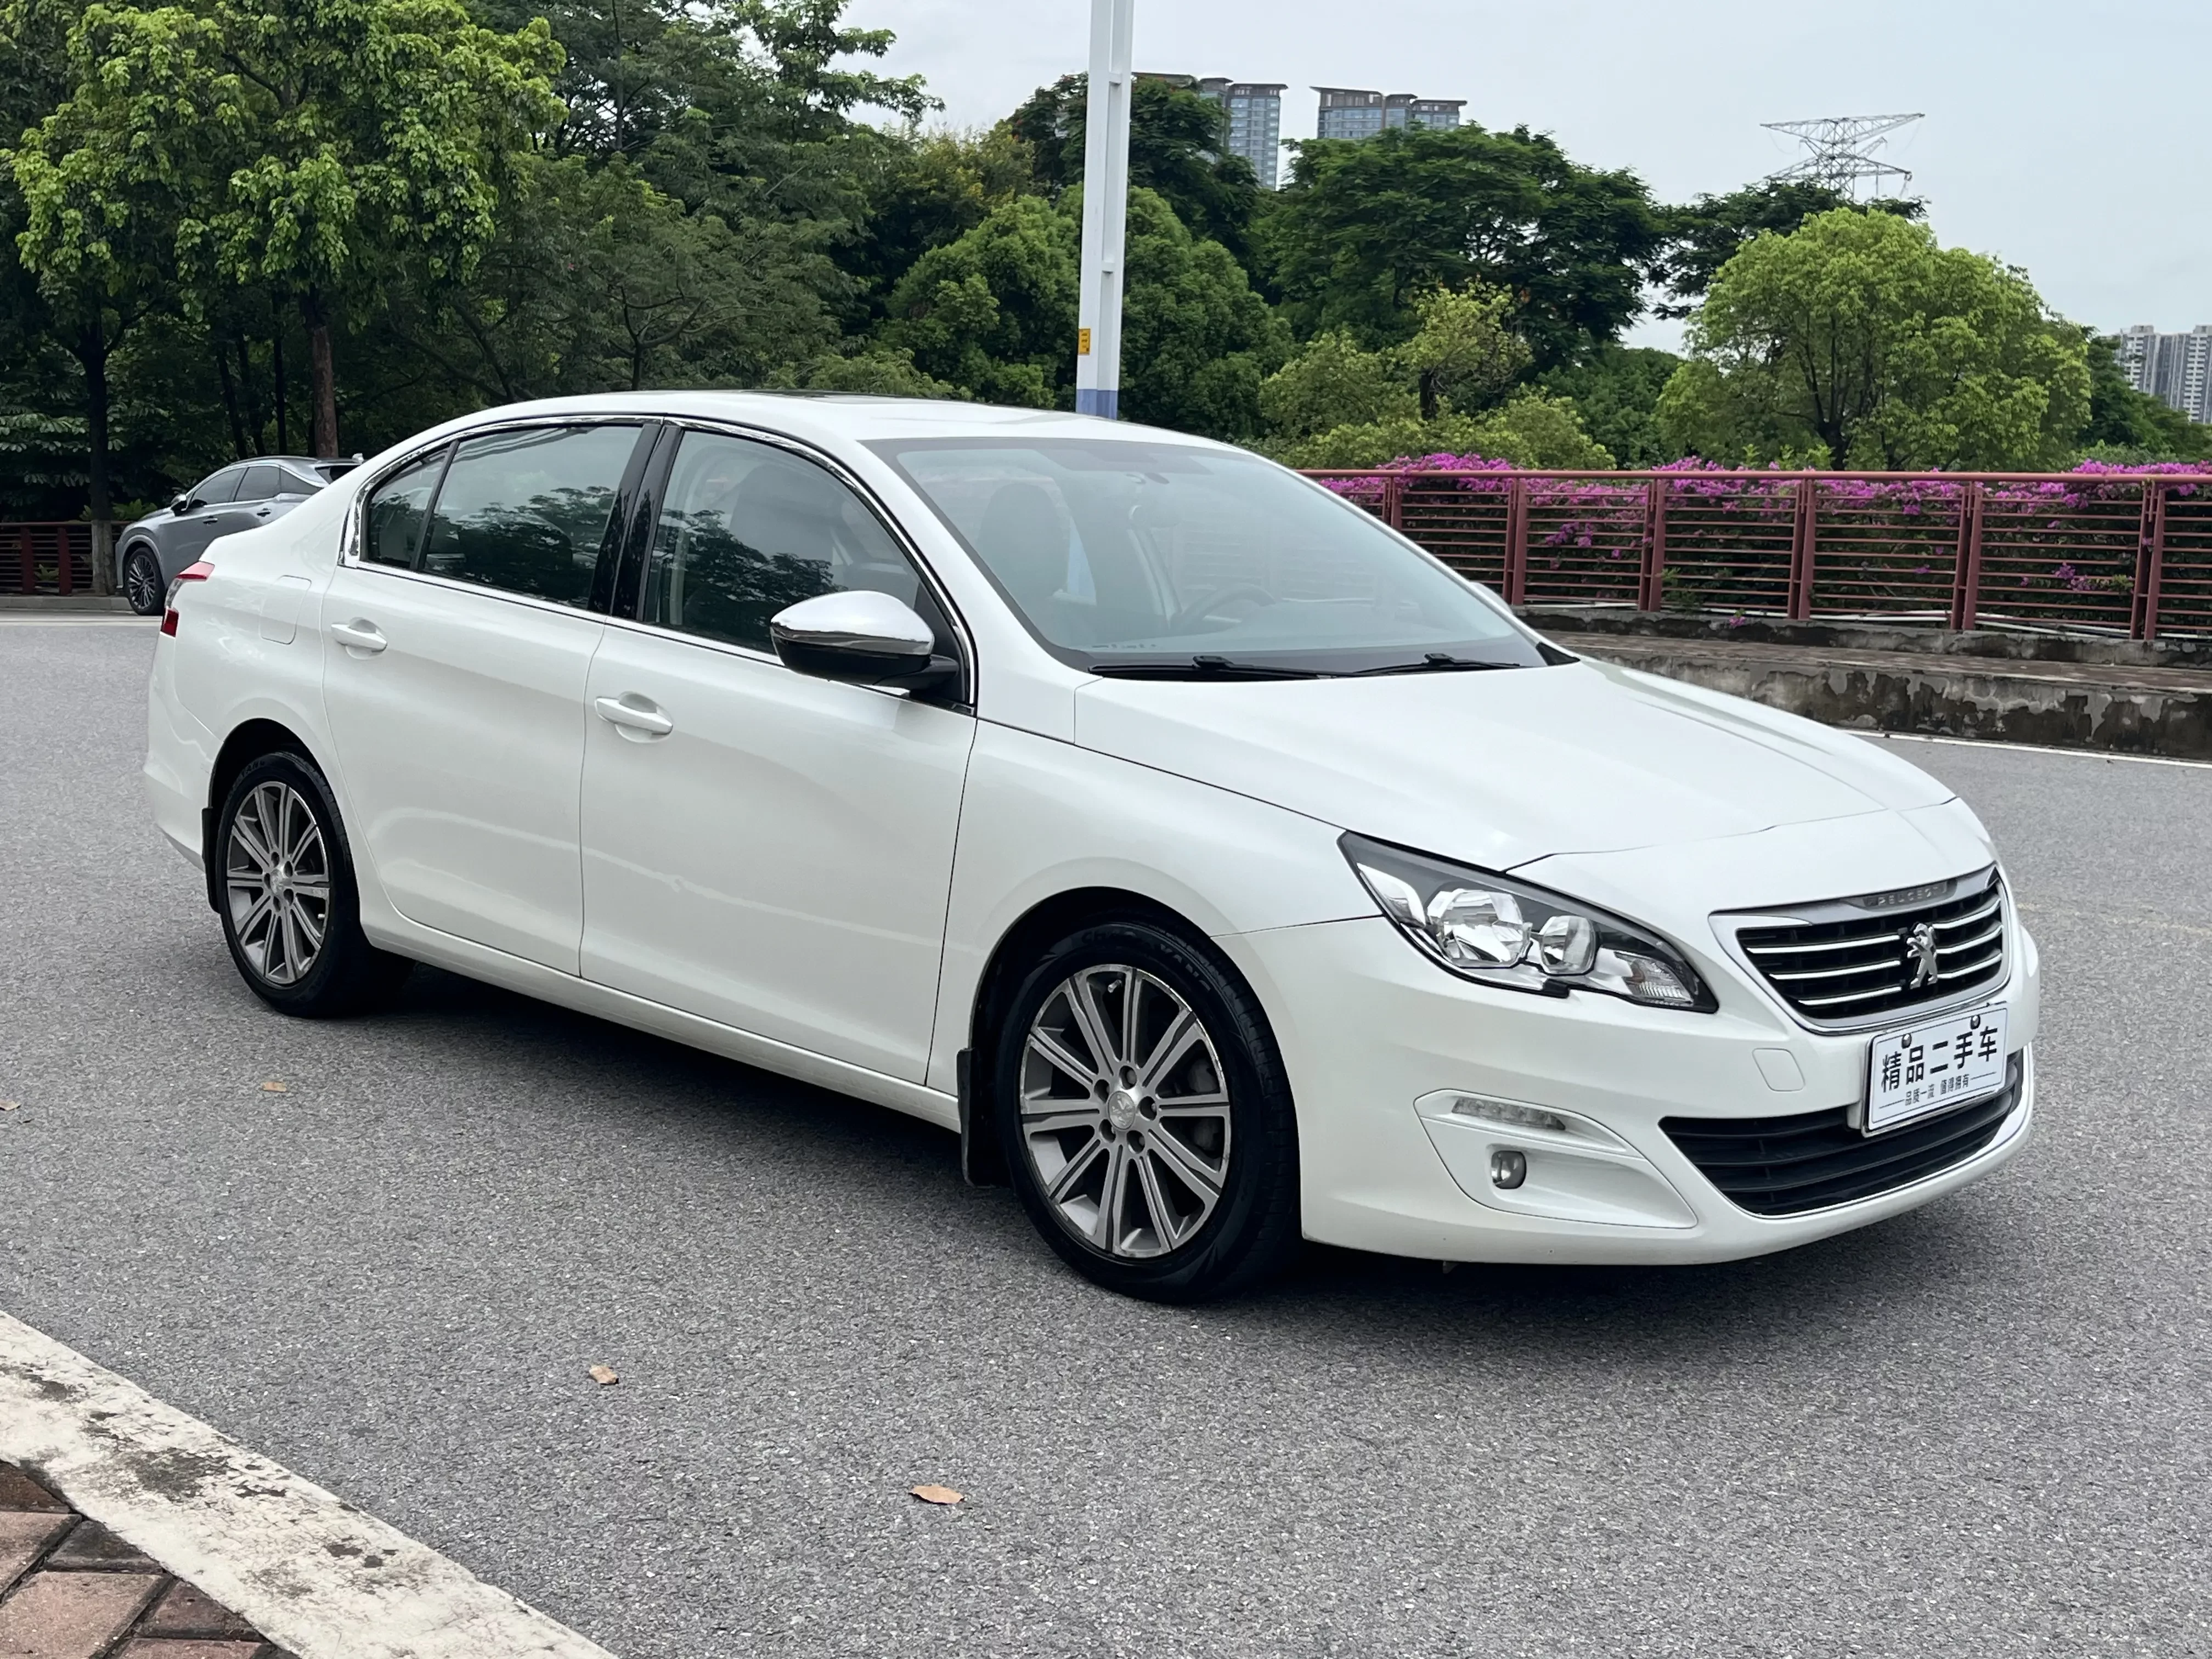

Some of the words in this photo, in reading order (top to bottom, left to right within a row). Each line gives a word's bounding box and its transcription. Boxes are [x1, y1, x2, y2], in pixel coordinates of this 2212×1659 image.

[1881, 1025, 1998, 1093] 精品二手车
